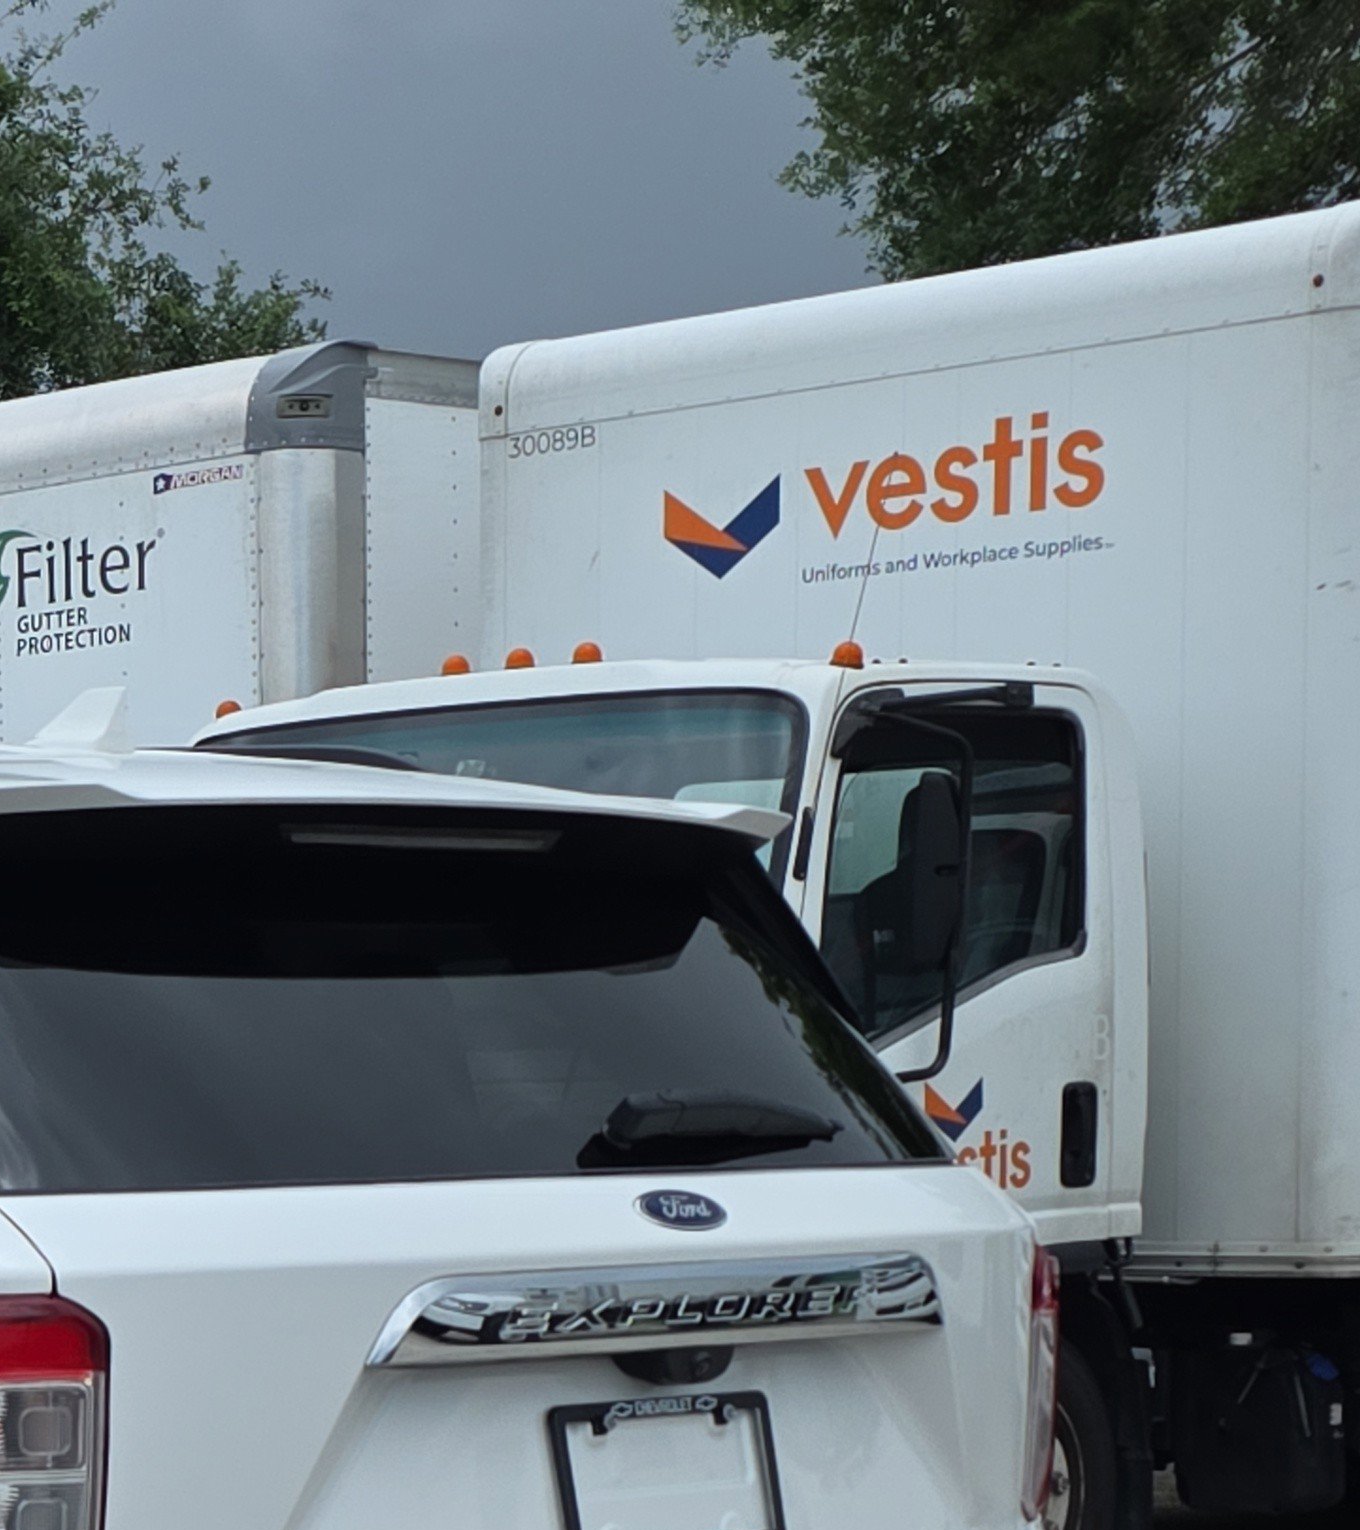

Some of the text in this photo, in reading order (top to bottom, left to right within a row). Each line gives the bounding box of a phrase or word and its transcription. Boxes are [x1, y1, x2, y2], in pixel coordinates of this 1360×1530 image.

[508, 425, 596, 459] 30089B
[169, 464, 244, 489] MORGAN
[804, 411, 1106, 540] vestis
[802, 563, 880, 584] Uniforms
[885, 553, 918, 574] and
[923, 545, 1019, 569] Workplace
[17, 606, 88, 634] GUTTER
[17, 623, 131, 657] PROTECTION
[659, 1195, 711, 1219] Ford
[499, 1277, 873, 1341] EXPLORER
